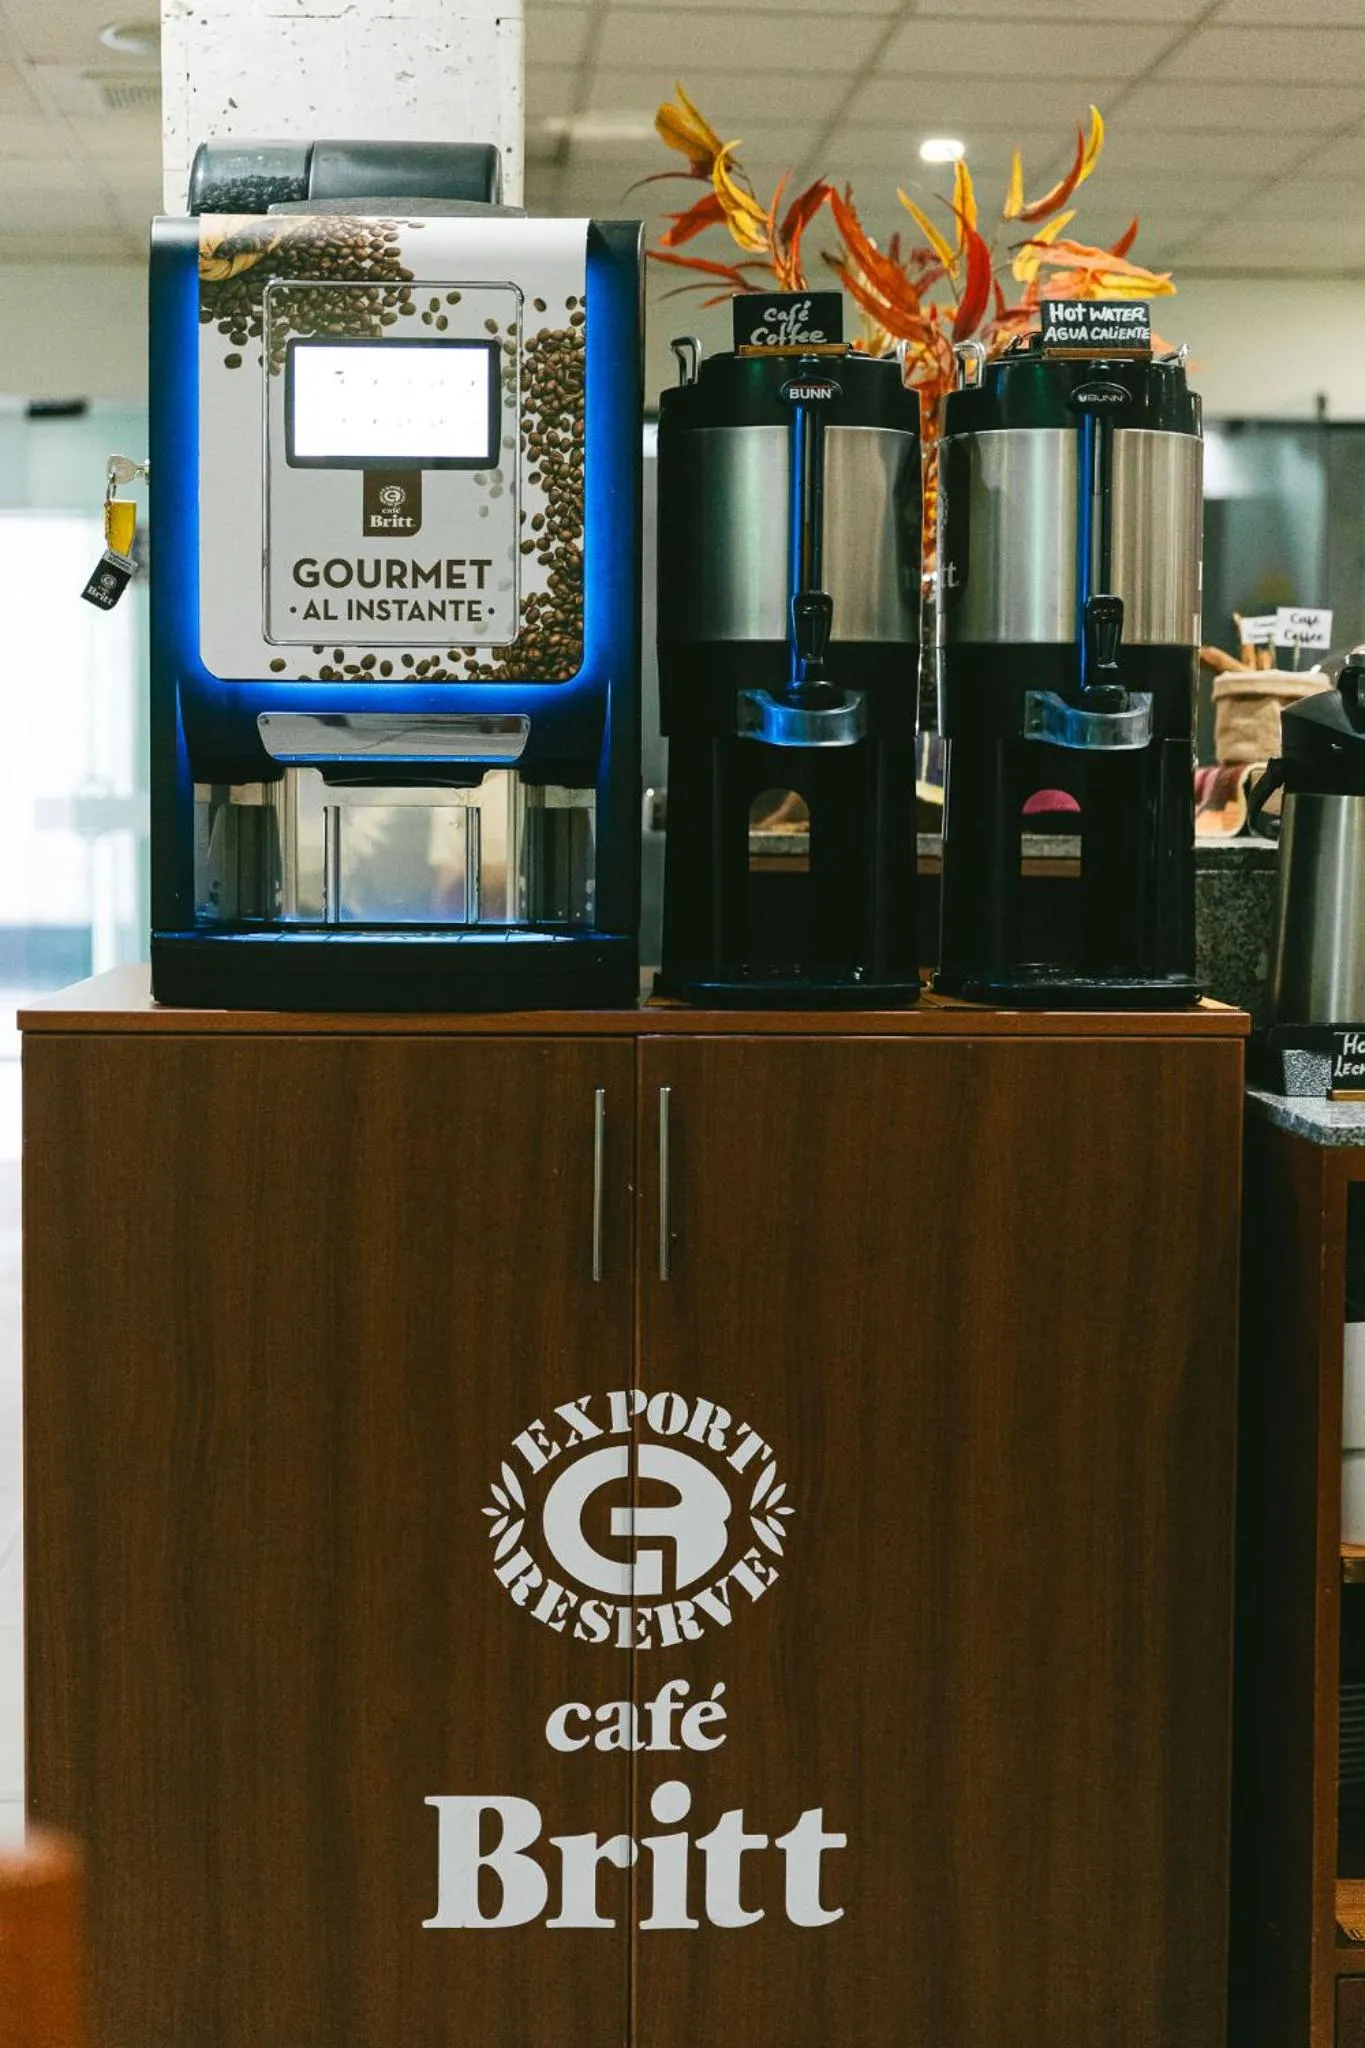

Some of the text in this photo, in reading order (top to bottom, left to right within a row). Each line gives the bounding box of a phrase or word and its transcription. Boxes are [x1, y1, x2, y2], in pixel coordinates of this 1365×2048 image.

[750, 322, 828, 346] Coffee
[1043, 325, 1089, 342] AGUA
[789, 388, 831, 399] BUNN
[369, 514, 414, 528] Britt
[292, 557, 493, 589] GOURMET
[302, 598, 483, 622] AL INSTANTE
[510, 1388, 773, 1475] EXPORT
[493, 1545, 781, 1650] RESERVE
[545, 1679, 727, 1752] café
[421, 1780, 847, 1930] Britt
